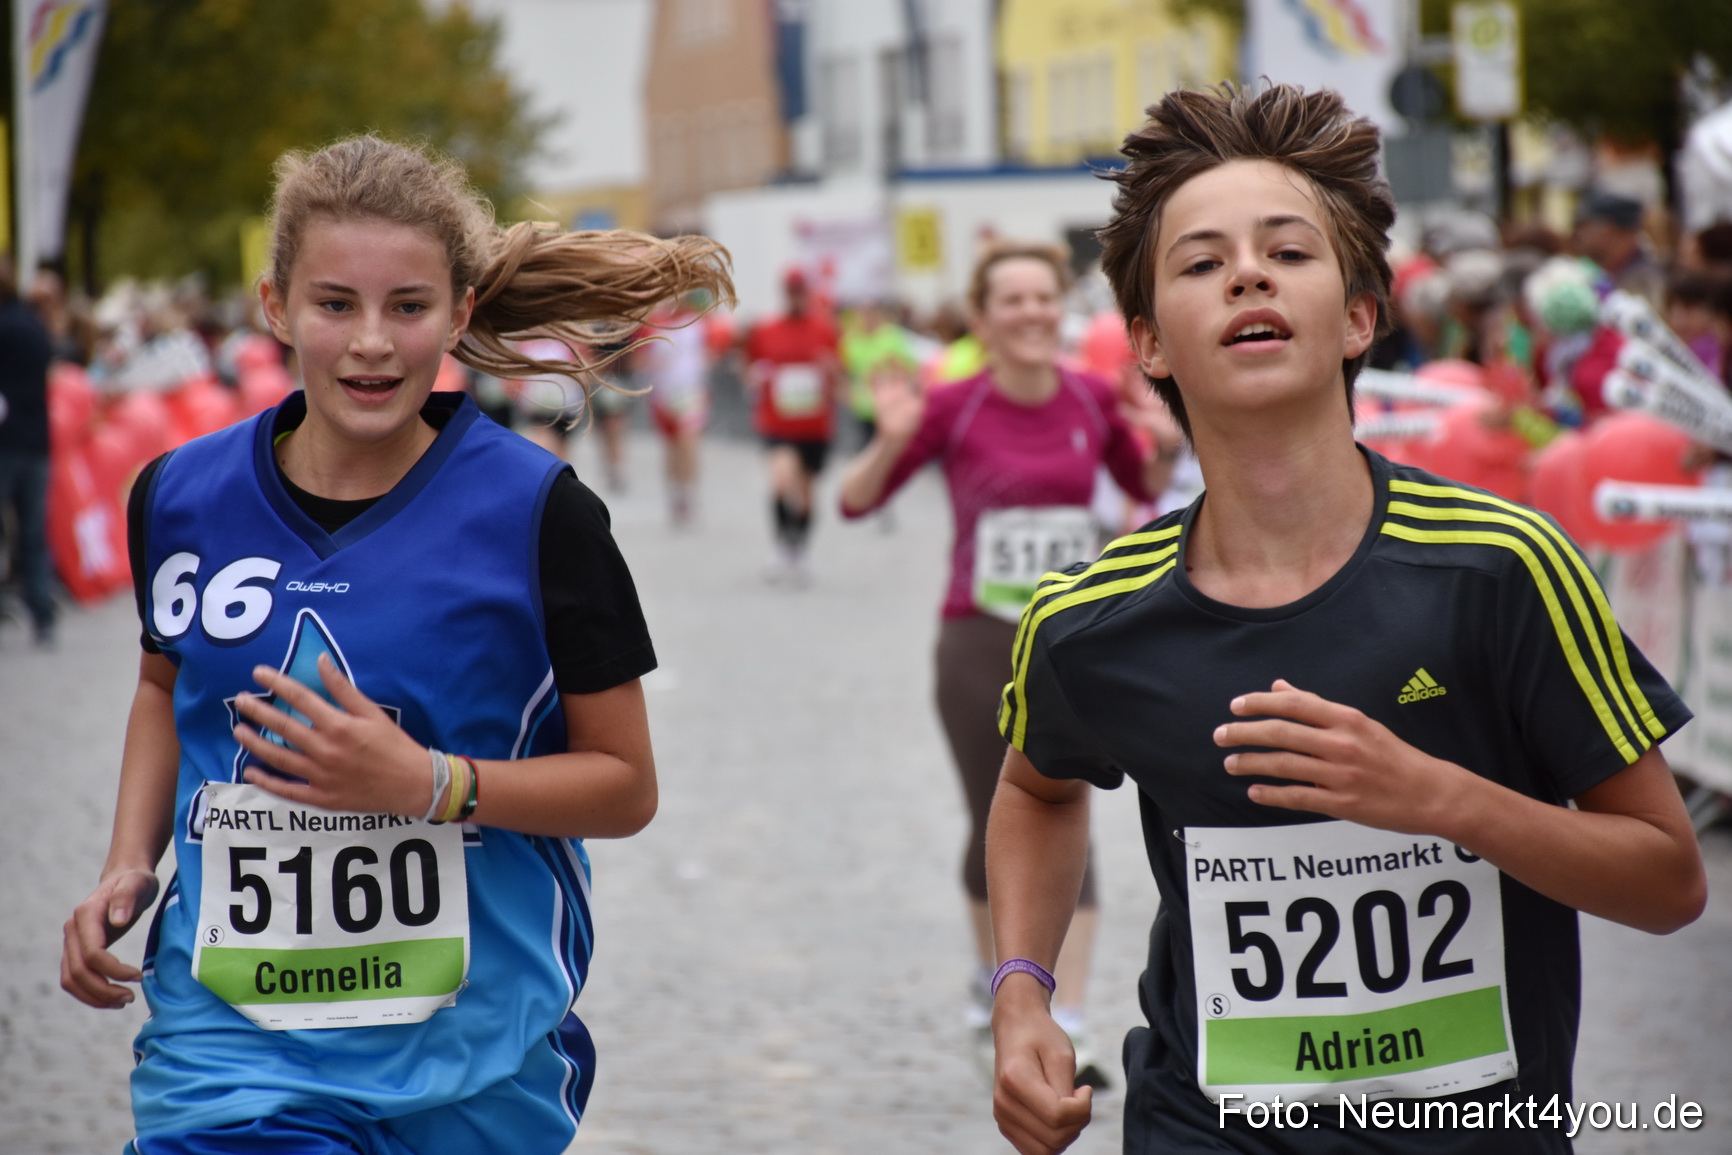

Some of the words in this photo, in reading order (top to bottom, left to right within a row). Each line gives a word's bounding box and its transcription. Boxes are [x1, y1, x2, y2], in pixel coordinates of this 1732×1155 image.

[152, 551, 282, 640] 66
[1398, 687, 1447, 704] adidas
[209, 808, 283, 831] PARTL
[289, 810, 412, 832] Neumarkt
[1195, 858, 1287, 881] PARTL
[1293, 842, 1443, 880] Neumarkt
[229, 838, 441, 935] 5160
[1224, 879, 1474, 1002] 5202
[255, 956, 402, 995] Cornelia
[1295, 1027, 1425, 1071] Adrian
